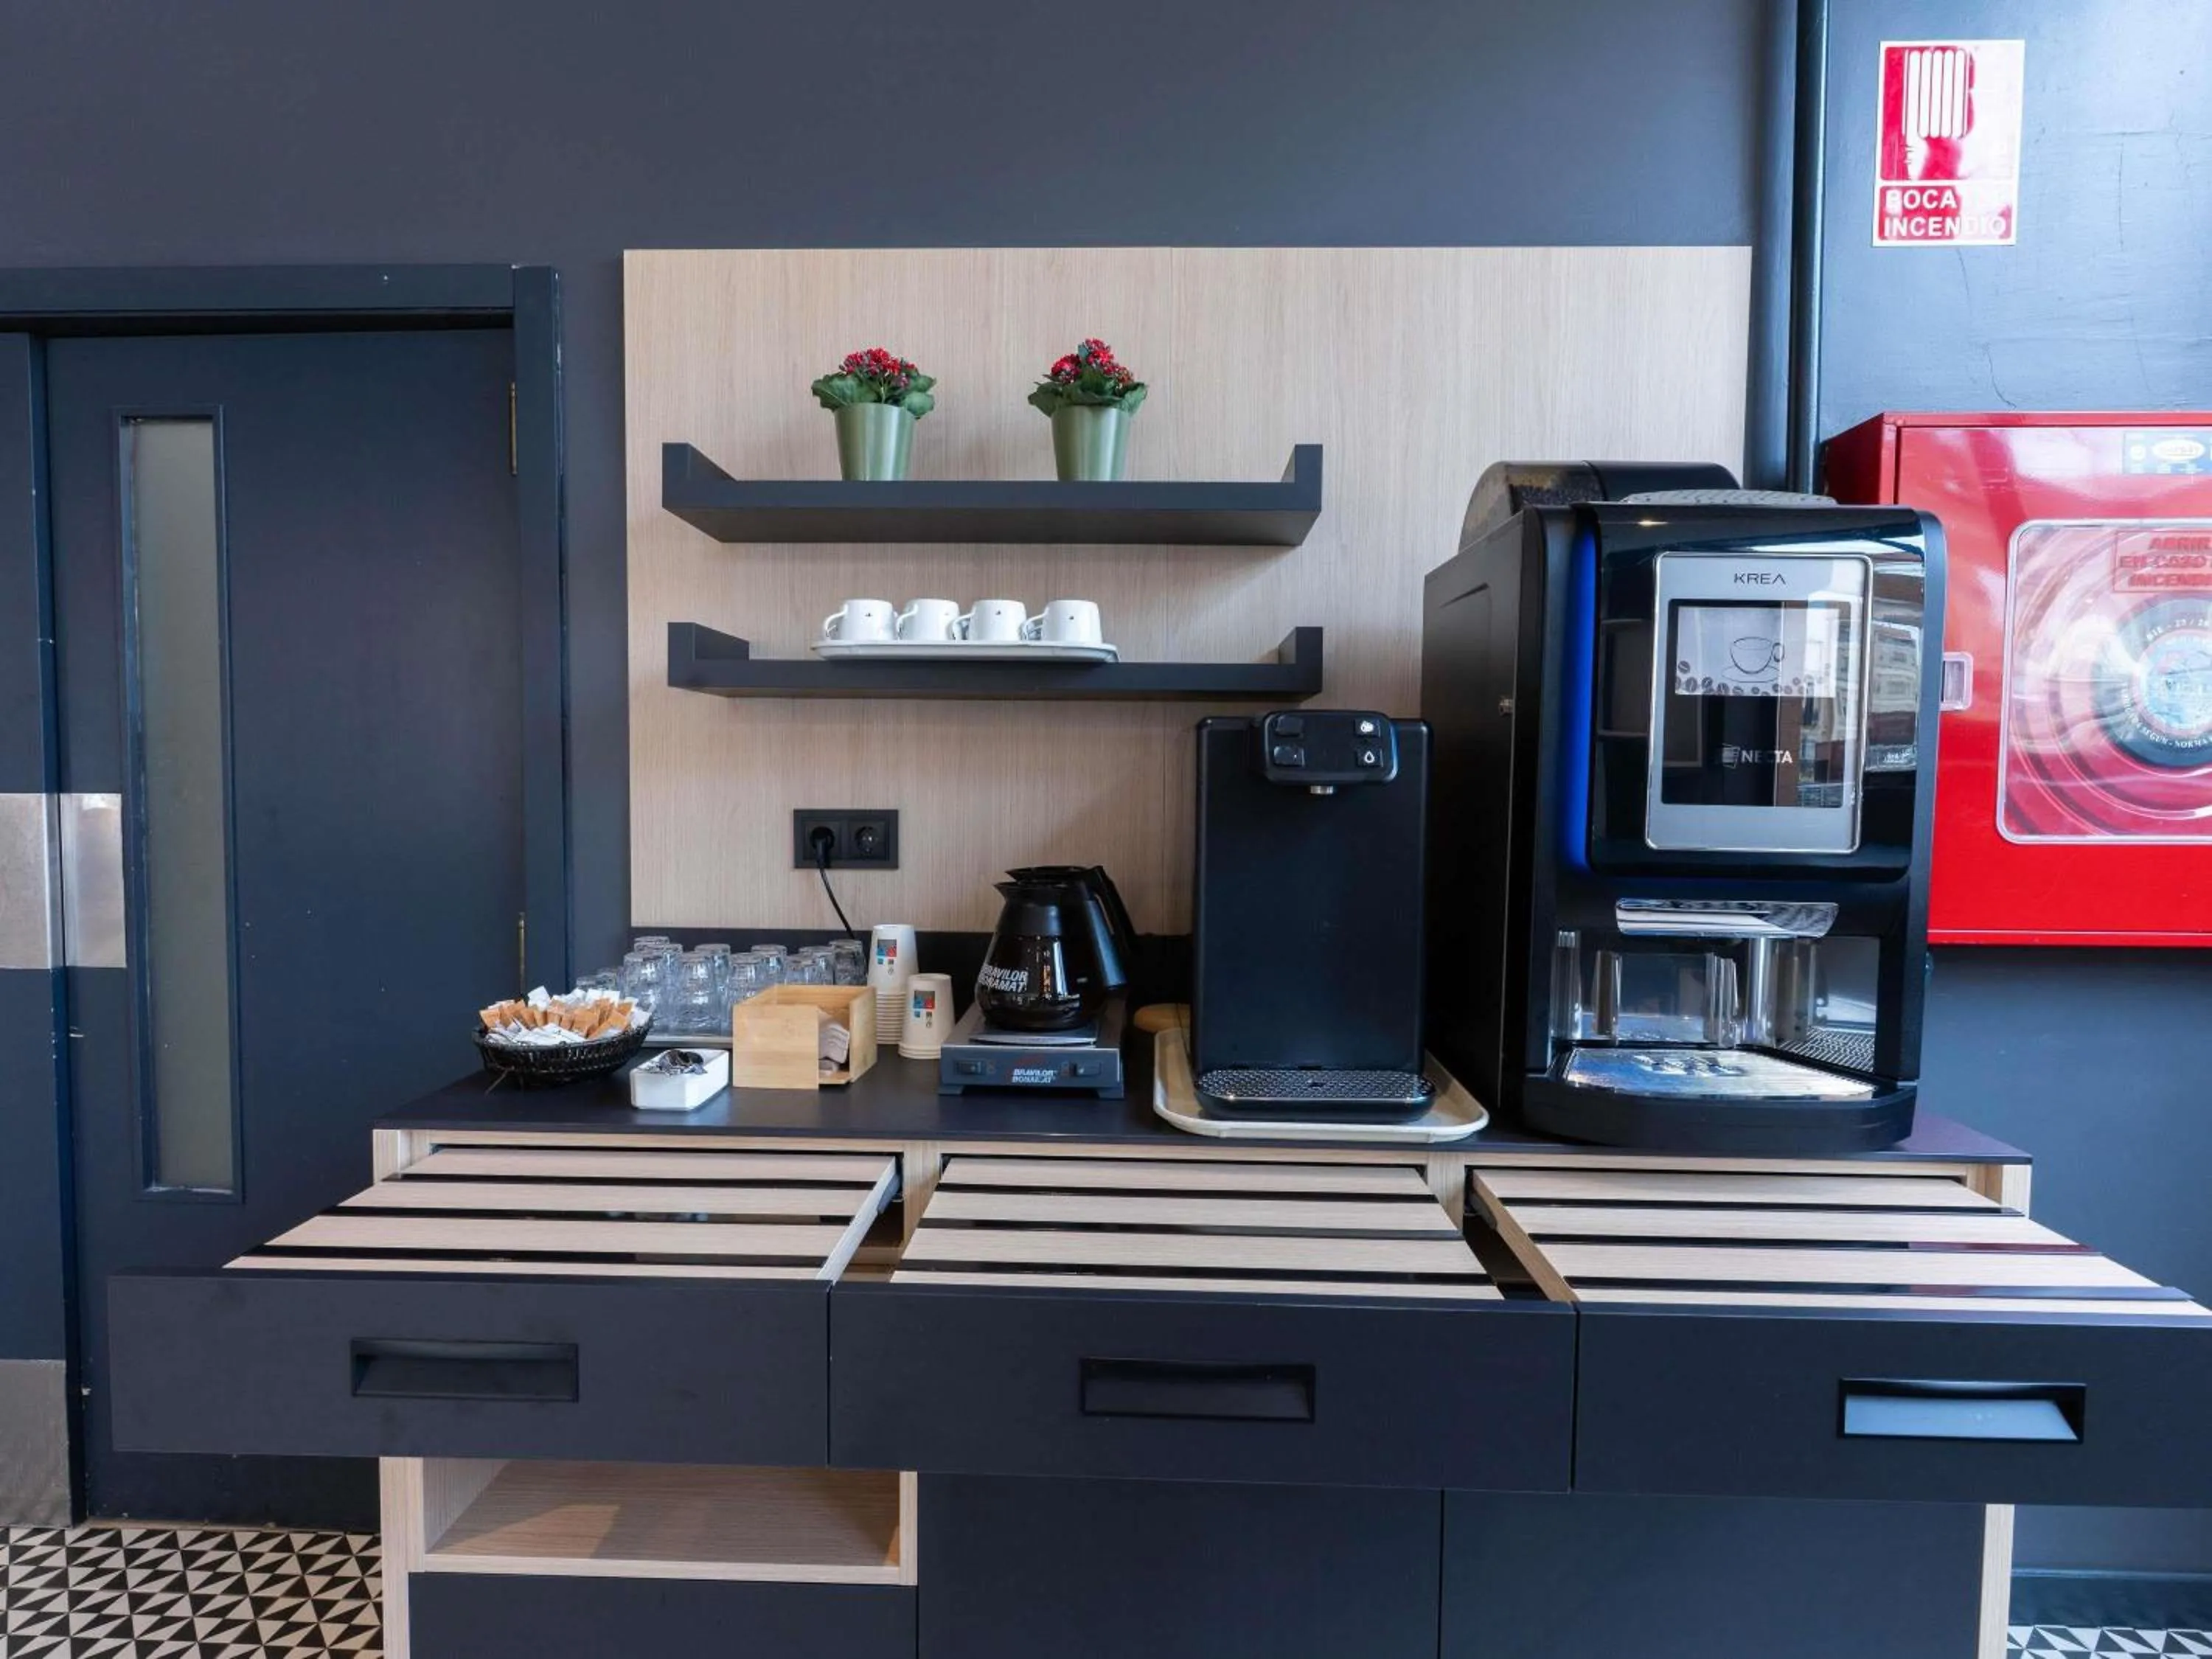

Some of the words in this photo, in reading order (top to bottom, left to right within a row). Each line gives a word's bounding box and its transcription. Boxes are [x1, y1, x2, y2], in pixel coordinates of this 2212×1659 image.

[1885, 189, 1957, 209] BOCA
[1884, 216, 2006, 237] INCENDIO
[1733, 573, 1786, 584] KREA
